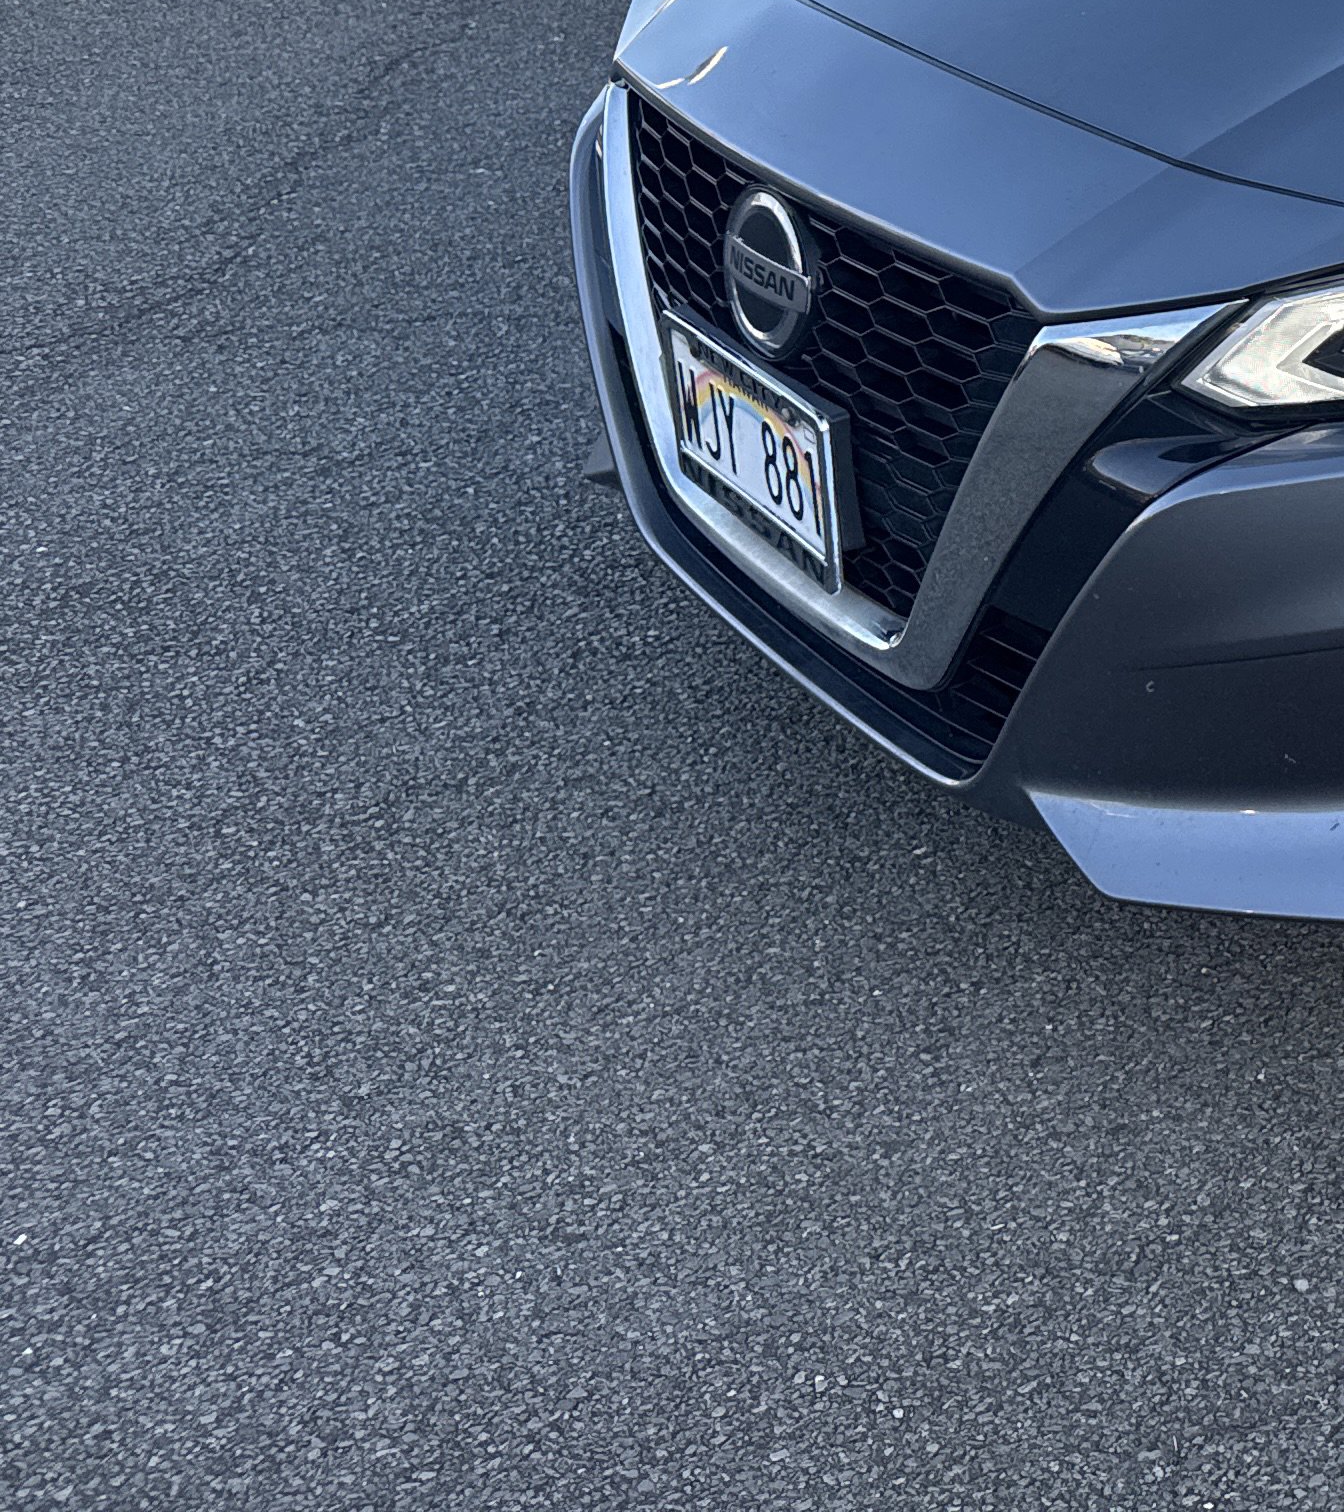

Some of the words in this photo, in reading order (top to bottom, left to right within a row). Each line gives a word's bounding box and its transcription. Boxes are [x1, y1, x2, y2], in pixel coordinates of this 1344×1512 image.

[729, 245, 795, 301] NISSAN
[677, 360, 738, 475] WJY
[761, 420, 822, 537] 881
[682, 458, 825, 586] NISSAN
